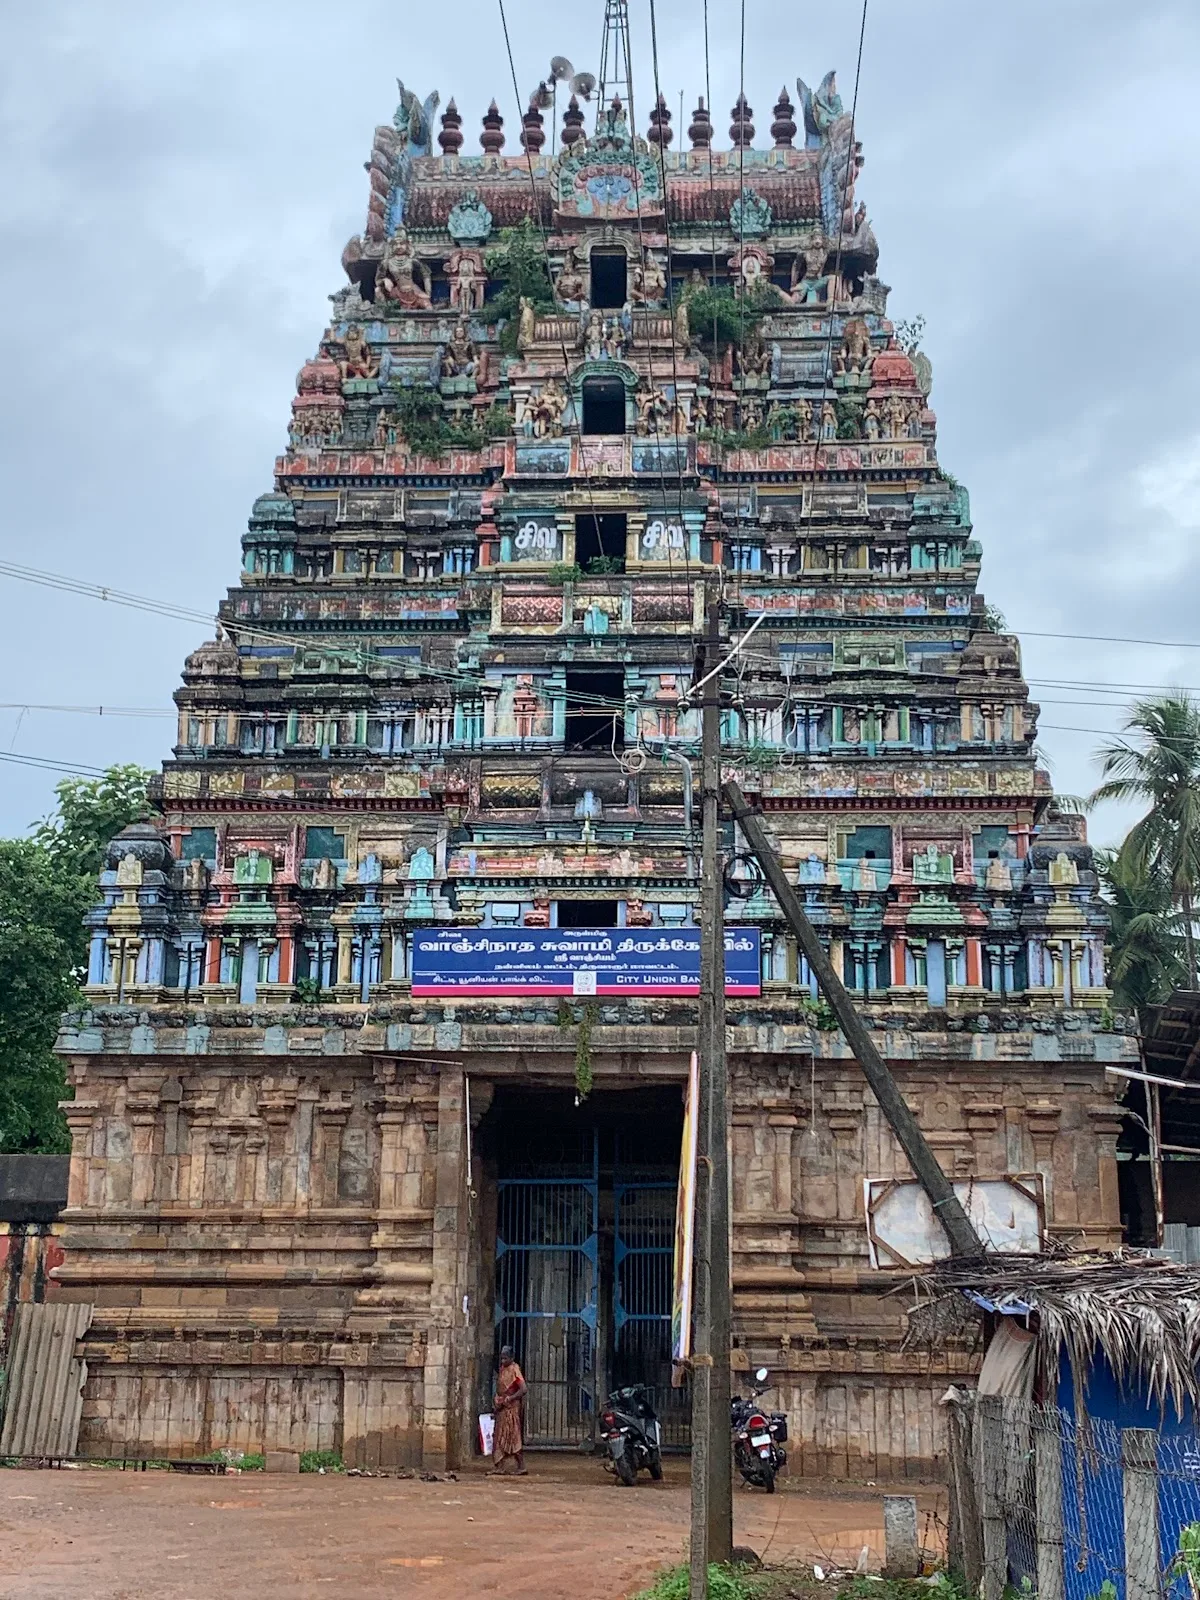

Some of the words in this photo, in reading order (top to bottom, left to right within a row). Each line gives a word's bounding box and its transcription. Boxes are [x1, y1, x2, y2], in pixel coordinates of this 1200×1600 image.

[514, 521, 557, 549] சிவ
[643, 520, 684, 548] சிவ
[418, 937, 536, 955] வாஞ்சிநாத
[540, 937, 612, 952] சுவாமி
[569, 952, 617, 962] வாஞ்சியம்
[433, 975, 456, 984] சிட்டி
[458, 975, 498, 984] யூனியன்
[616, 975, 640, 984] CITY
[643, 975, 677, 984] UNION
[680, 975, 700, 984] BAN
